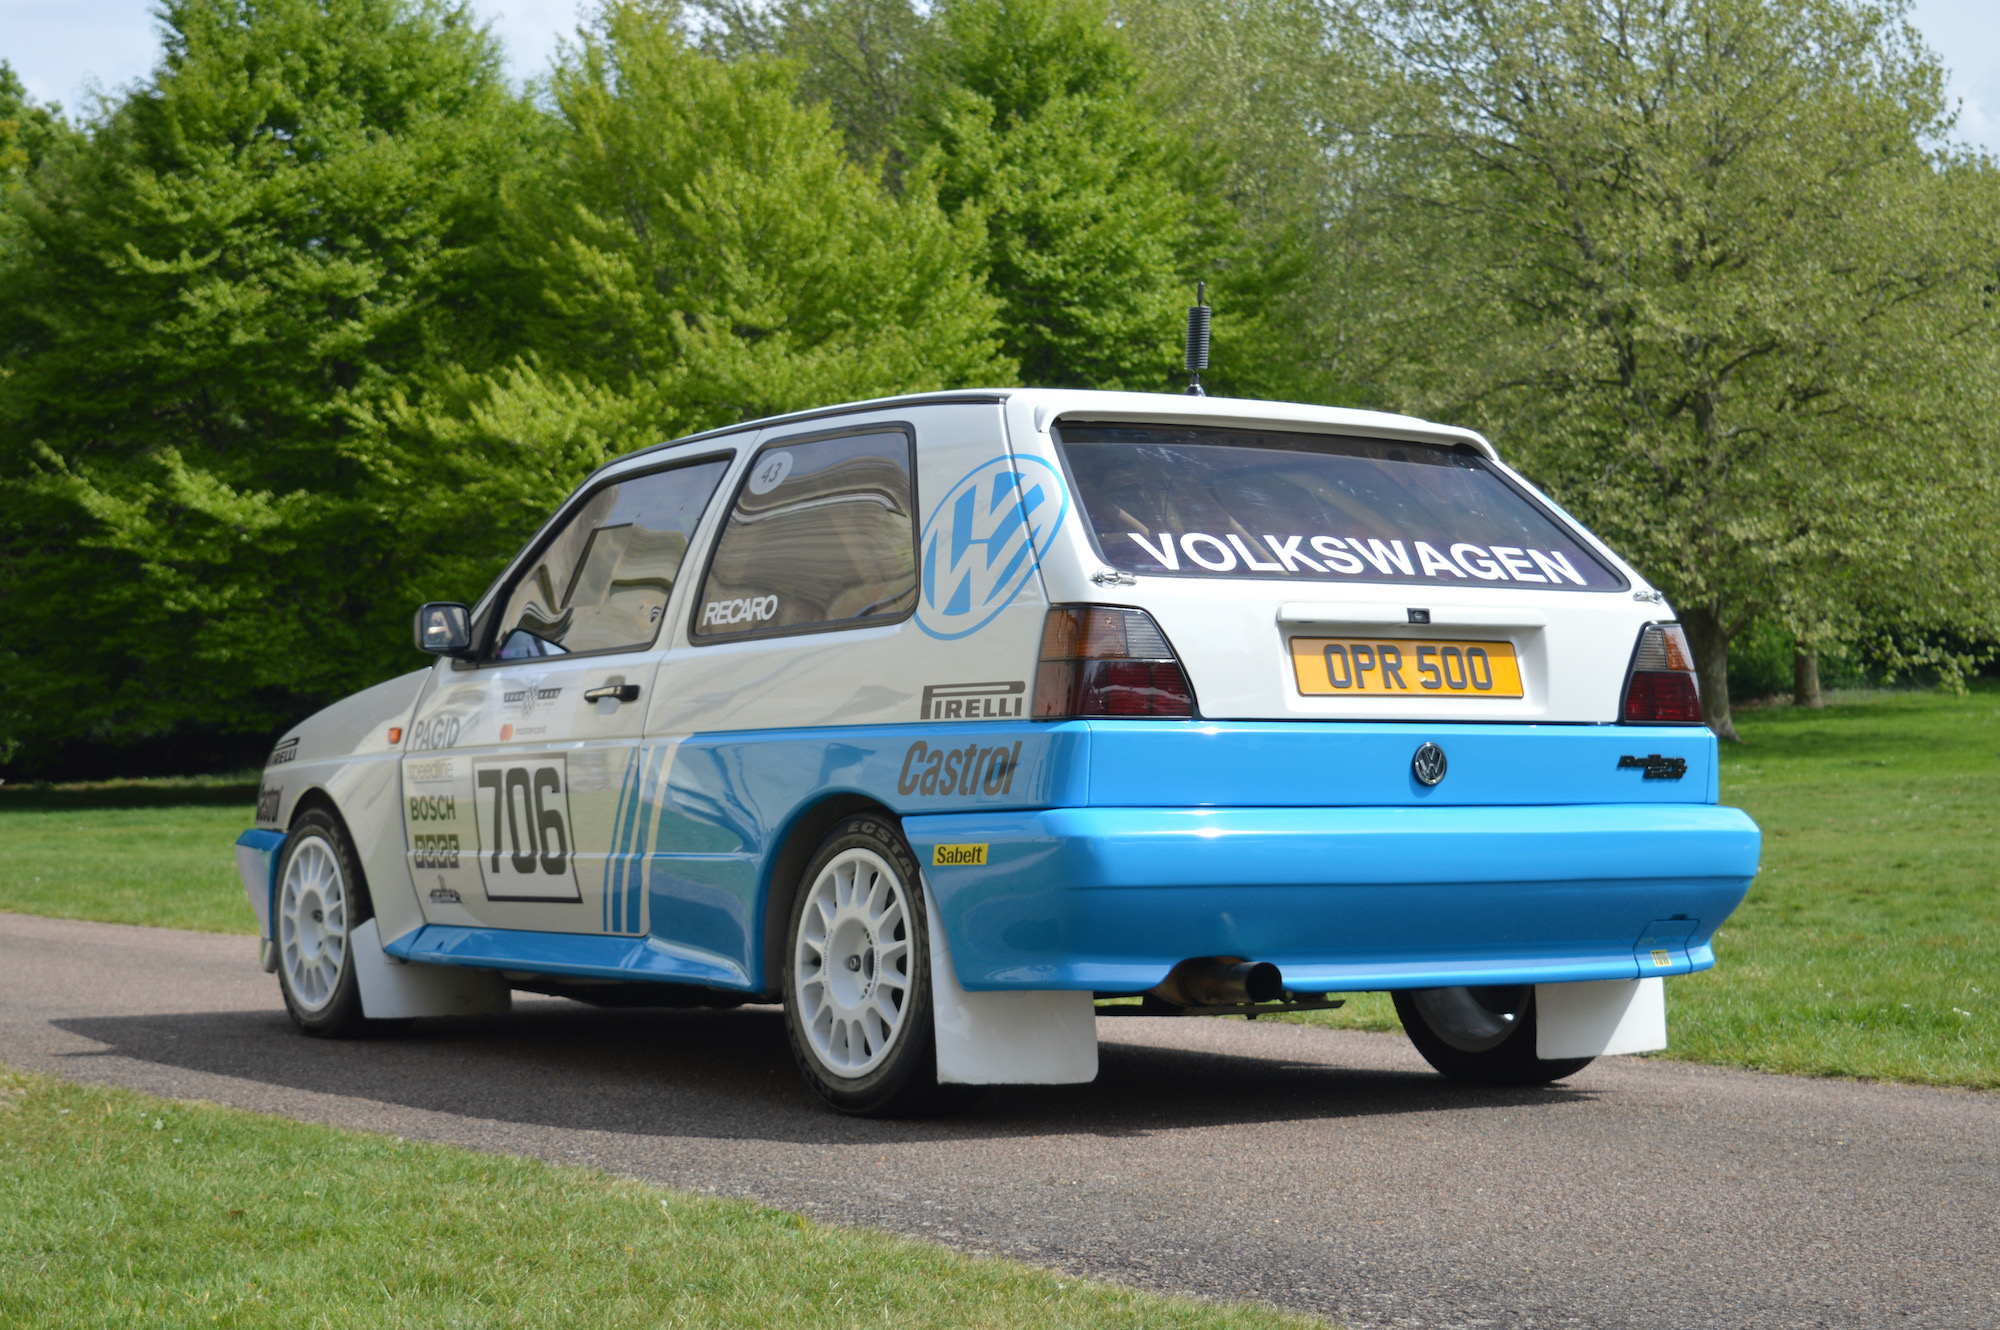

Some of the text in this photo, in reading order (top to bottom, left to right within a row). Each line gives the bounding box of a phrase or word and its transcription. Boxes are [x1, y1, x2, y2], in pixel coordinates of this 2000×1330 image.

[759, 461, 783, 485] 43
[1127, 531, 1587, 586] VOLKSWAGEN
[701, 593, 779, 627] RECARO
[1322, 643, 1494, 691] OPR 500
[920, 680, 1026, 720] PIRELLI
[412, 716, 460, 751] PAGID
[897, 739, 1024, 797] Castrol
[410, 794, 457, 821] BOSCH
[477, 766, 568, 875] 706
[846, 820, 915, 878] ECSTA
[936, 845, 984, 864] Sabelt
